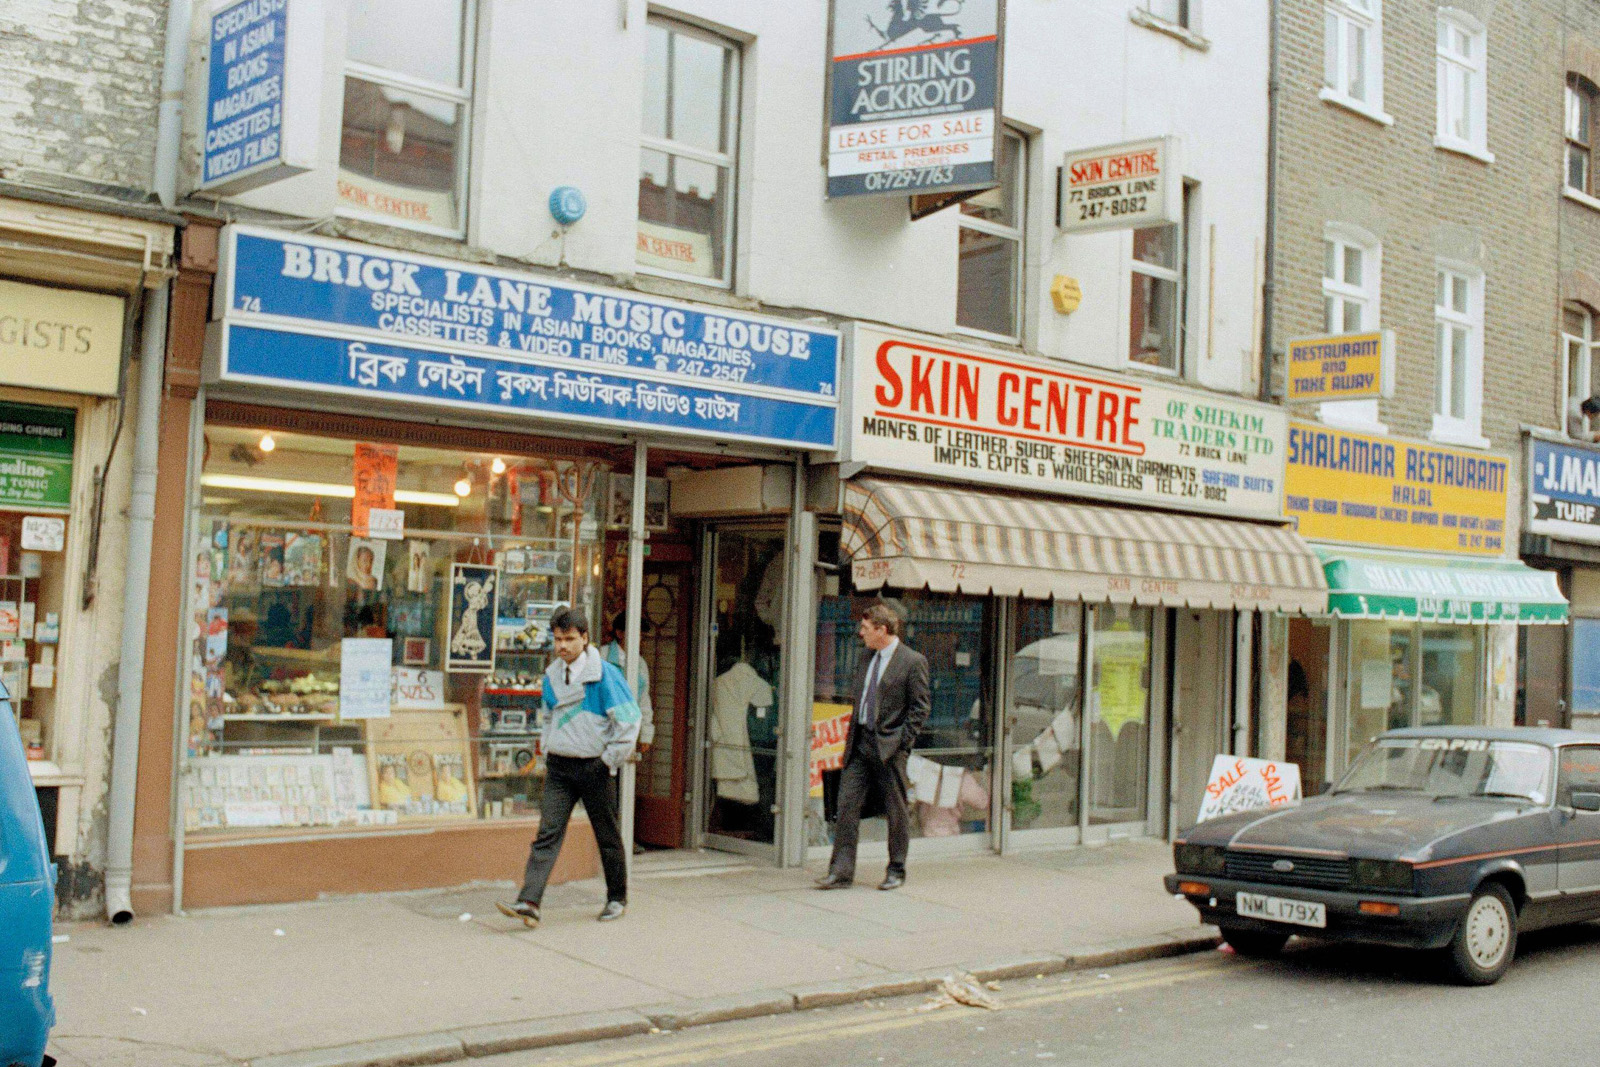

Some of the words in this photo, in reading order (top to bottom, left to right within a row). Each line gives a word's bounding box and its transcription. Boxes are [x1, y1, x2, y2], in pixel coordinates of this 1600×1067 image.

[214, 0, 285, 41] SPECIALISTS
[223, 39, 238, 65] IN
[239, 19, 276, 58] ASIAN
[227, 51, 269, 91] BOOKS
[857, 48, 972, 87] STIRLING
[212, 75, 281, 124] MAGAZINES
[851, 76, 977, 115] ACKROYD
[206, 107, 272, 153] CASSETTES
[271, 102, 281, 127] &
[838, 128, 888, 149] LEASE
[897, 124, 933, 143] FOR
[942, 116, 984, 137] SALE
[208, 147, 242, 179] VIDEO
[242, 131, 279, 168] FILMS
[857, 148, 898, 163] RETAIL
[903, 142, 970, 158] PREMISES
[1070, 159, 1103, 184] SKIN
[1108, 152, 1160, 178] CENTRE
[864, 166, 955, 191] 01-729-7763
[1087, 185, 1121, 200] BRICK
[1127, 180, 1156, 195] LANE
[1080, 196, 1147, 220] 247-8082
[241, 295, 262, 314] 74
[281, 243, 422, 296] BRICK
[443, 270, 552, 316] LANE
[572, 292, 686, 339] MUSIC
[702, 315, 812, 361] HOUSE
[370, 291, 494, 327] SPECIALISTS
[503, 311, 522, 331] IN
[531, 317, 584, 341] ASIAN
[591, 325, 656, 353] BOOKS,
[661, 339, 756, 370] MAGAZINES,
[378, 313, 489, 346] CASSETTES
[497, 330, 512, 350] &
[518, 332, 573, 358] VIDEO
[579, 342, 629, 367] FILMS
[676, 359, 749, 384] 247-2547
[1292, 340, 1379, 362] RESTAURANT
[818, 381, 834, 396] 74
[874, 339, 981, 422] SKIN
[996, 371, 1143, 448] CENTRE
[1294, 376, 1327, 393] TAKE
[1331, 373, 1375, 390] AWAY
[694, 393, 741, 423] হাউস
[1166, 400, 1188, 420] OF
[1193, 403, 1265, 435] SHEKIM
[862, 416, 921, 443] MANFS.
[924, 426, 943, 445] OF
[947, 429, 1008, 455] LEATHER
[1015, 439, 1057, 462] SUEDE
[1064, 447, 1133, 473] SHEEPSKIN
[1136, 459, 1196, 482] GARMENTS
[1151, 417, 1238, 449] TRADERS
[1242, 435, 1275, 455] LTD
[933, 445, 982, 469] IMPTS.
[987, 451, 1033, 476] EXPTS.
[1052, 462, 1143, 491] WHOLESALERS
[1179, 443, 1191, 457] 72
[1194, 445, 1222, 461] BRICK
[1227, 451, 1248, 465] LANE
[1288, 427, 1395, 478] SHALAMAR
[1405, 447, 1507, 493] RESTAURANT
[1201, 468, 1240, 488] SAFARI
[1243, 475, 1274, 494] SUITS
[1543, 451, 1600, 498] J.MA
[1392, 485, 1433, 507] HALAL
[1555, 500, 1596, 523] TURF
[950, 563, 966, 579] 72
[1106, 577, 1131, 592] SKIN
[1140, 579, 1180, 595] CENTRE
[417, 670, 428, 685] 6
[1418, 738, 1489, 751] CAPRI
[1206, 758, 1249, 799] SALE
[1259, 763, 1288, 808] SALE
[1242, 896, 1276, 917] NML
[1278, 902, 1320, 924] 179X
